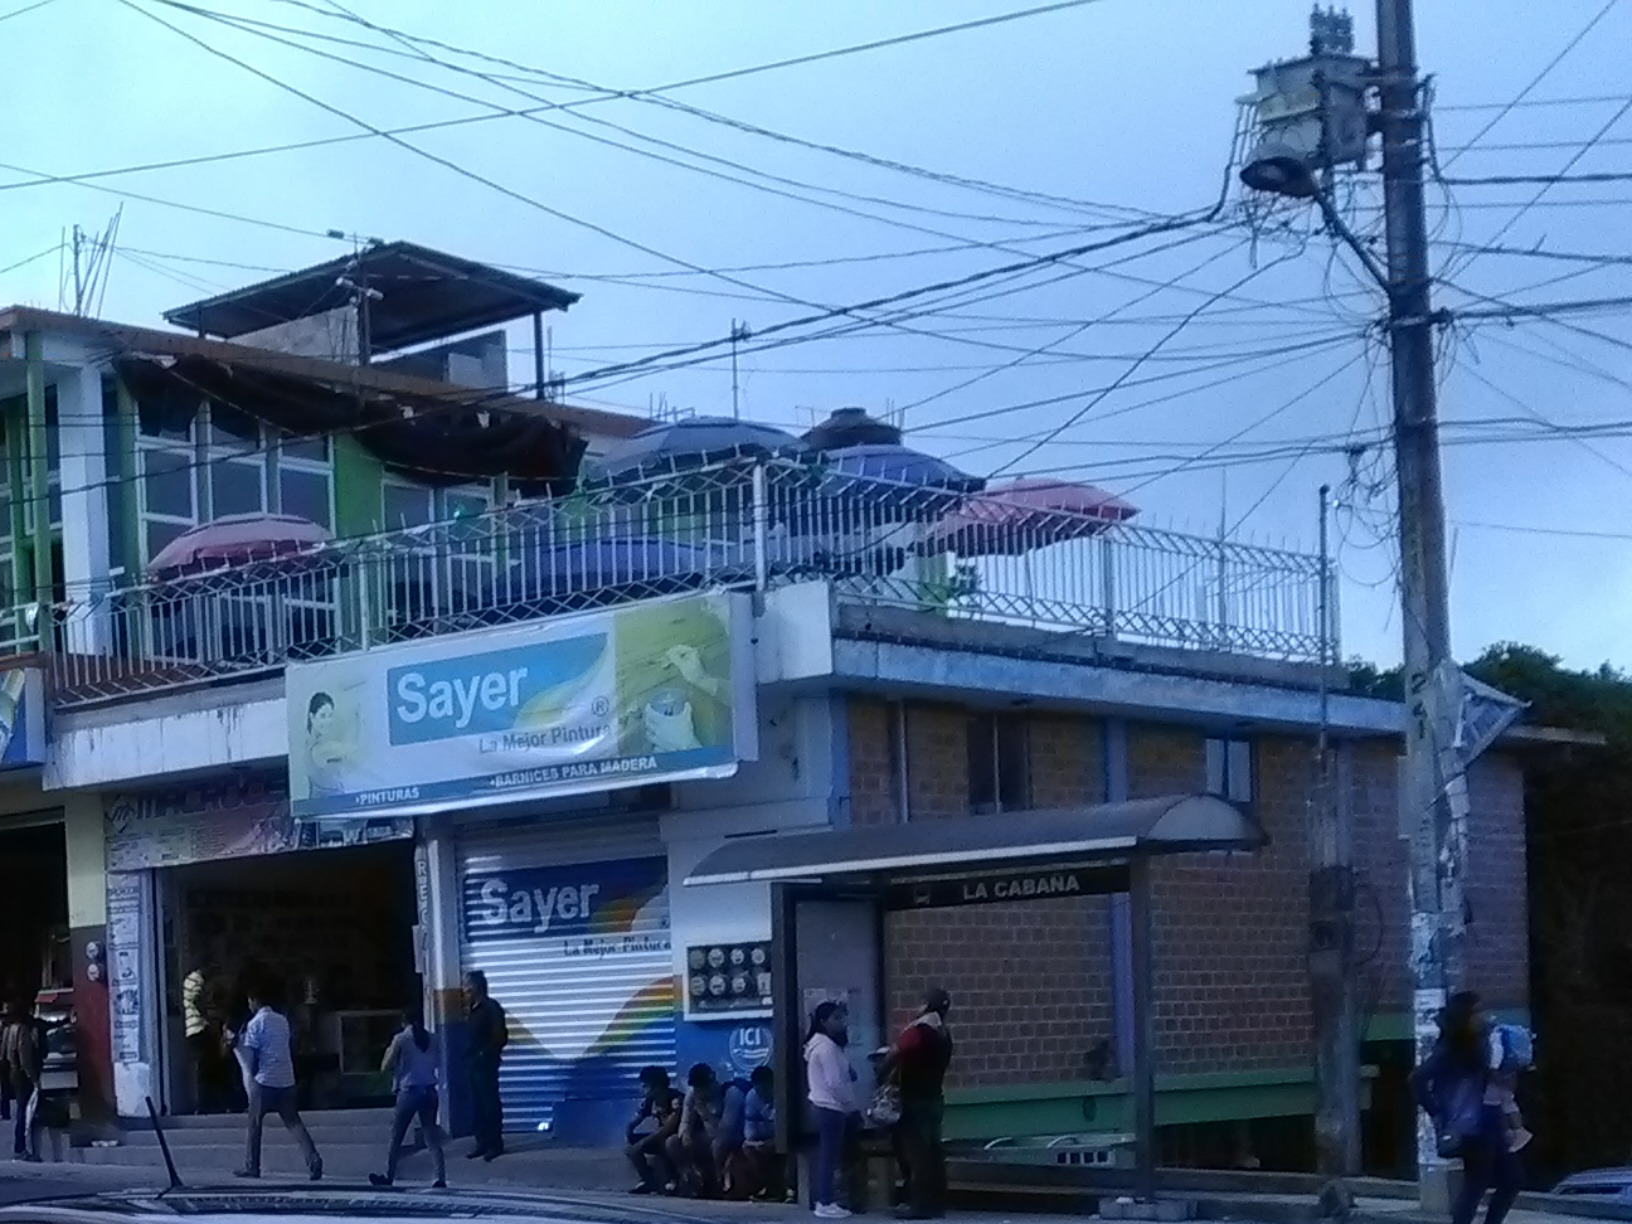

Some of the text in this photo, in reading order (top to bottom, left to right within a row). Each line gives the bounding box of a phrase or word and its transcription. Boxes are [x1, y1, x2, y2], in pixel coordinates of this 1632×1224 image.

[396, 667, 528, 729] Sayer
[479, 738, 497, 754] La
[502, 731, 546, 752] Mejor
[562, 760, 599, 778] PARA
[599, 755, 658, 775] MADERA
[963, 882, 988, 900] LA
[481, 877, 601, 933] Sayer
[564, 935, 672, 961] La Mejor Pintura
[739, 1026, 761, 1046] ICI
